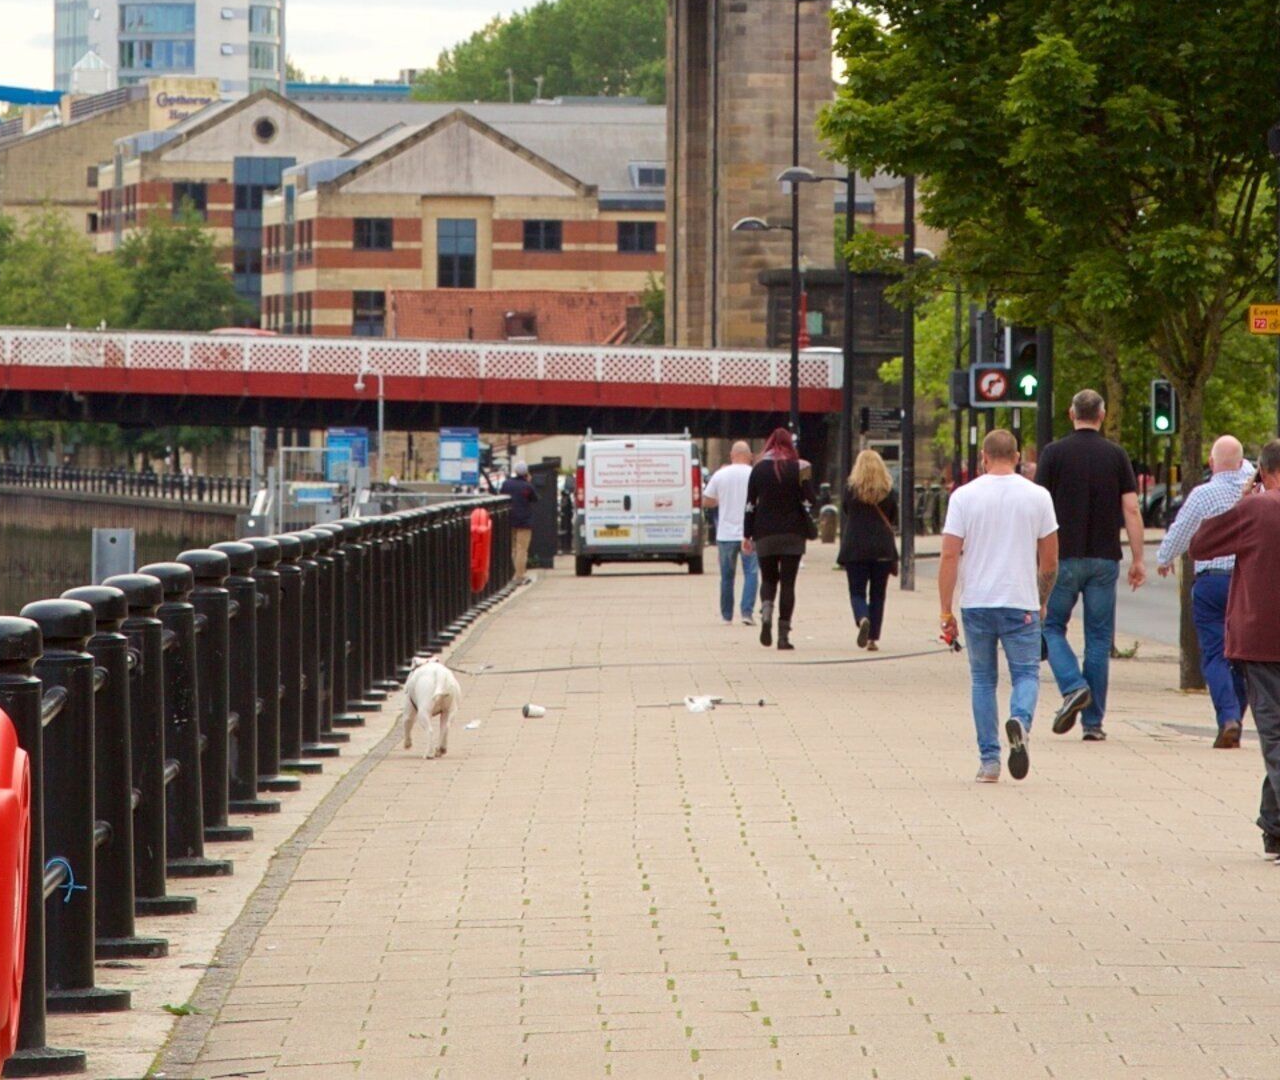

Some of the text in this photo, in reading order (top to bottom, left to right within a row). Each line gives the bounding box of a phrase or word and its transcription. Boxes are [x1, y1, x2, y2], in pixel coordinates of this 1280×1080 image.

[156, 91, 213, 108] Copthorne
[1253, 307, 1279, 316] Event
[1255, 319, 1267, 328] 72
